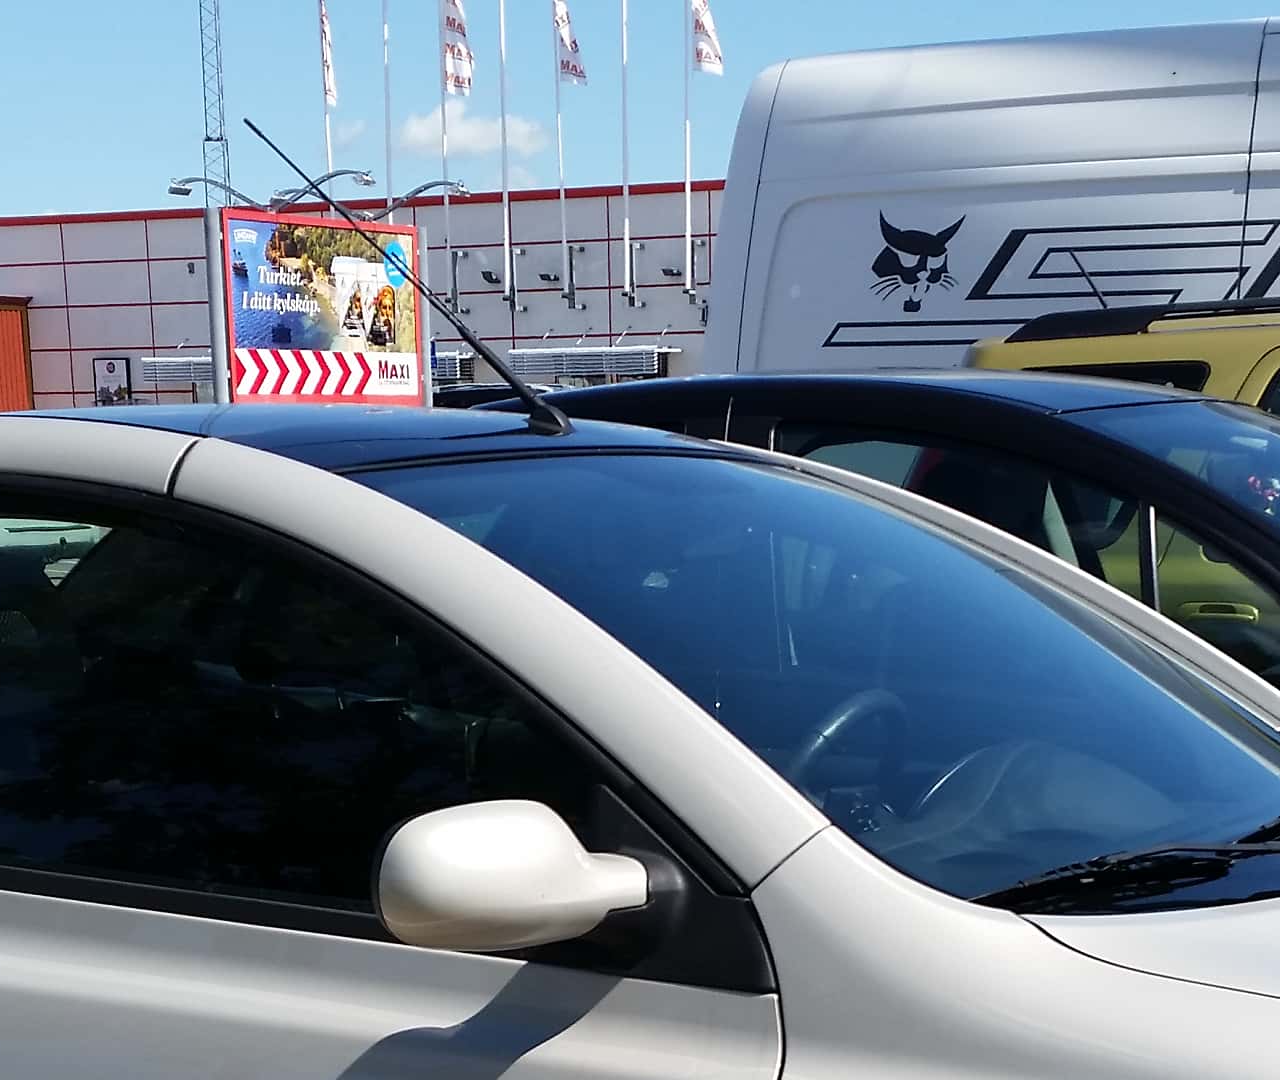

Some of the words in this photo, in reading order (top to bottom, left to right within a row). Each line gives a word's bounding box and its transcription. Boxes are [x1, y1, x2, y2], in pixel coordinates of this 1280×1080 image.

[257, 265, 304, 286] Turkiet.
[242, 291, 249, 309] I
[250, 291, 272, 311] ditt
[273, 292, 321, 316] kylskåp.
[378, 359, 410, 379] MAXI
